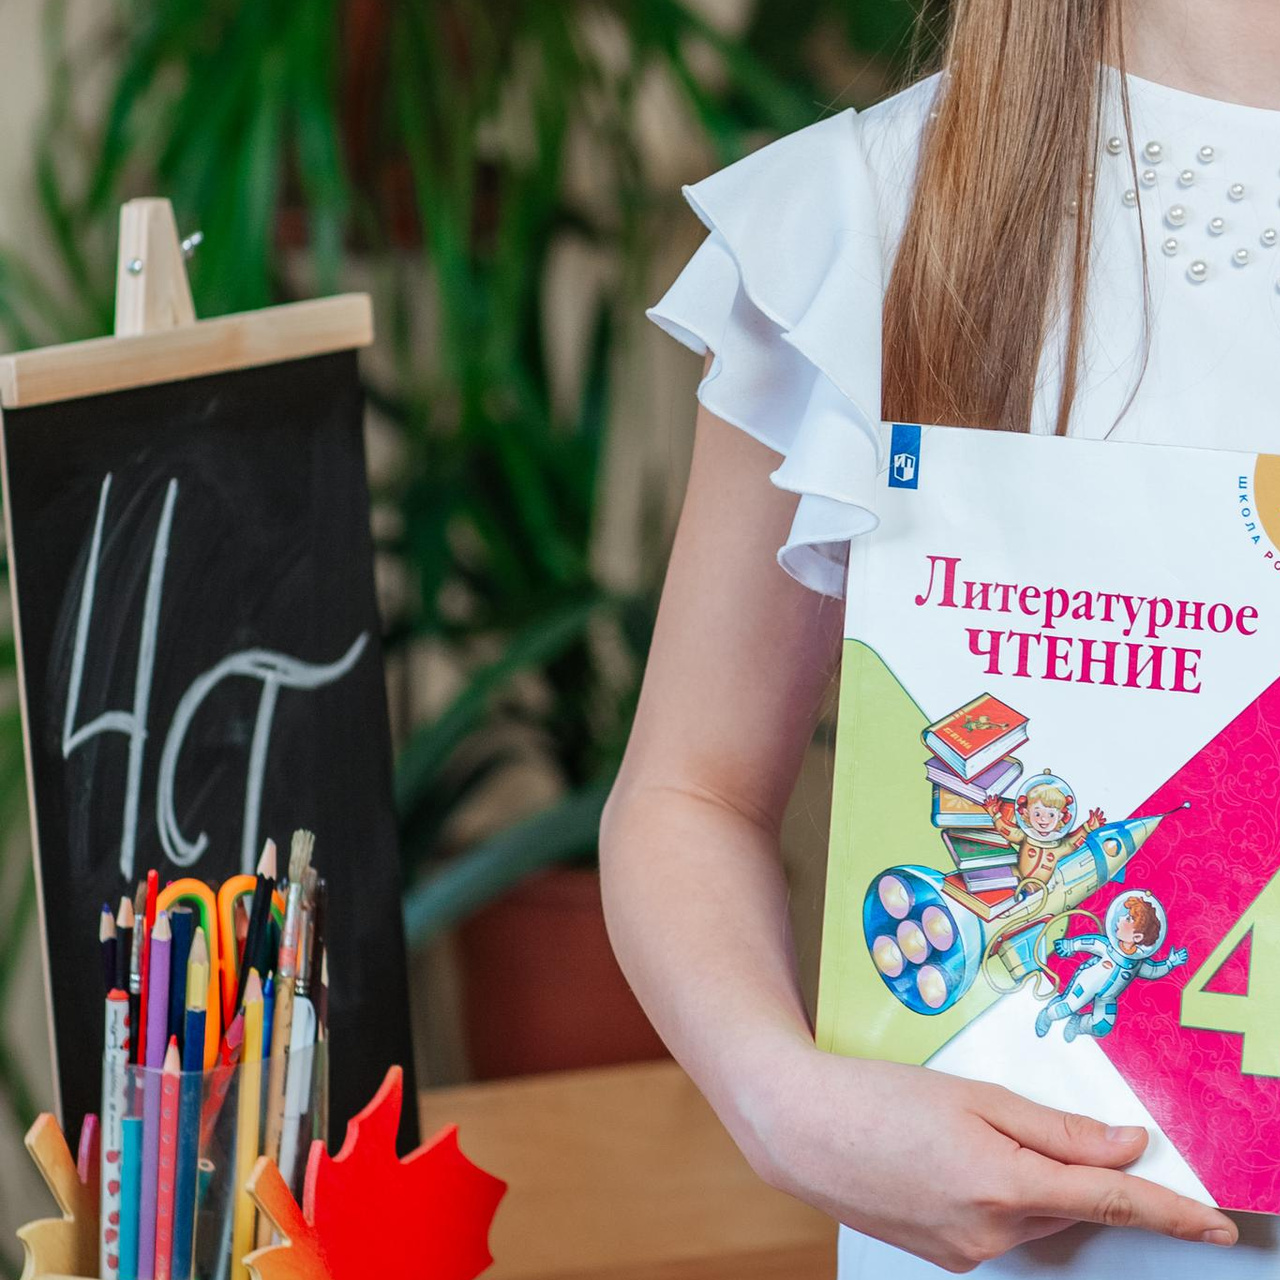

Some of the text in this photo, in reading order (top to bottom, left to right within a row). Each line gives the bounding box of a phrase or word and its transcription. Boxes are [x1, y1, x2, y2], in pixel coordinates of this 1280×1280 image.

[1237, 475, 1261, 545] ШКОЛА
[914, 554, 1260, 639] Литературное
[964, 627, 1203, 695] ЧТЕНИЕ
